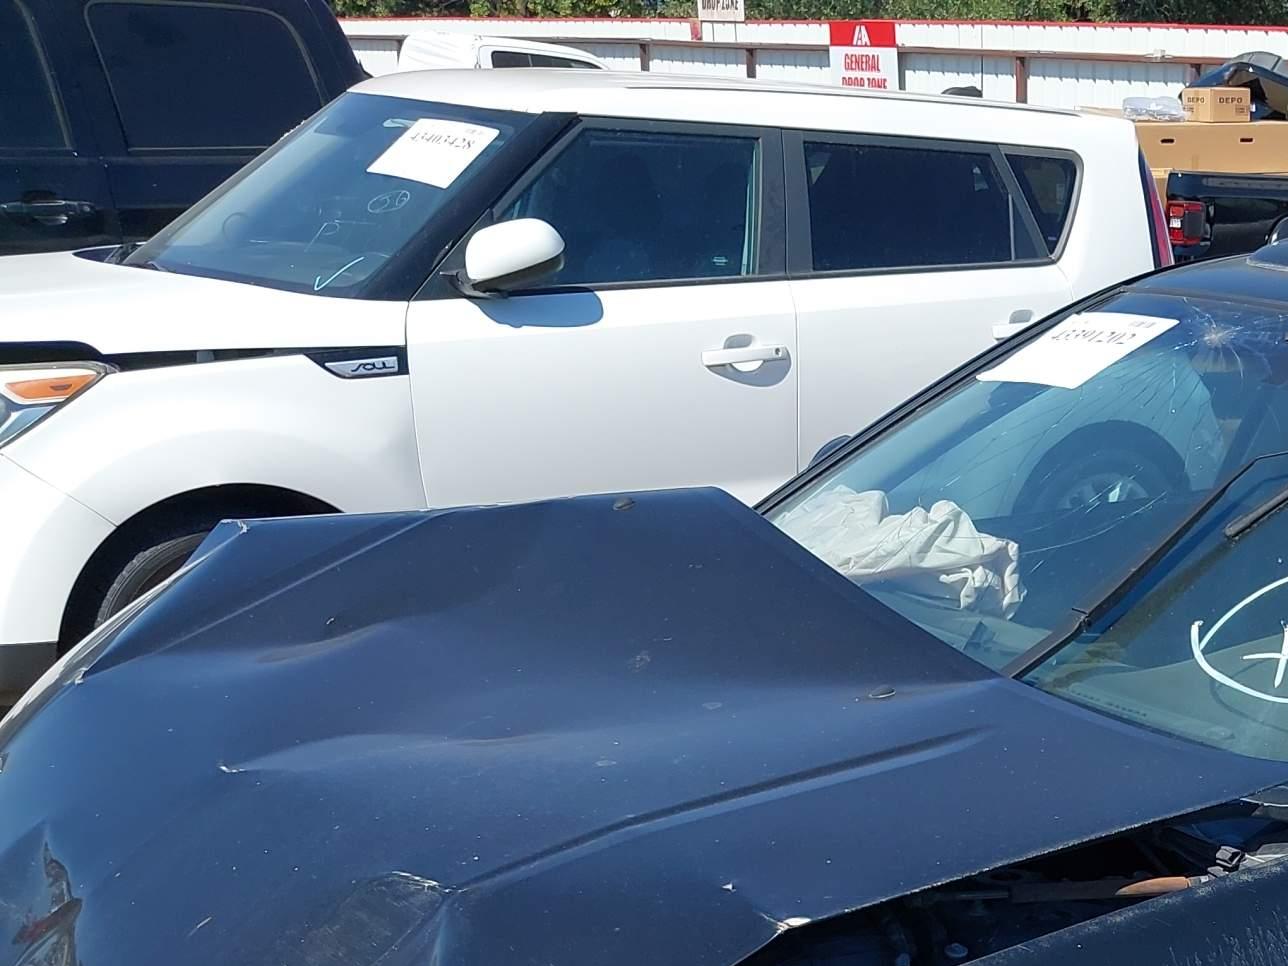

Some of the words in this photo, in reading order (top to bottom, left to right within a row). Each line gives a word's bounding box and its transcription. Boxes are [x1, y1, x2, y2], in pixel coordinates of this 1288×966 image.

[844, 53, 880, 72] GENERAL
[1187, 96, 1205, 104] DEPO
[1218, 96, 1243, 104] DEPO
